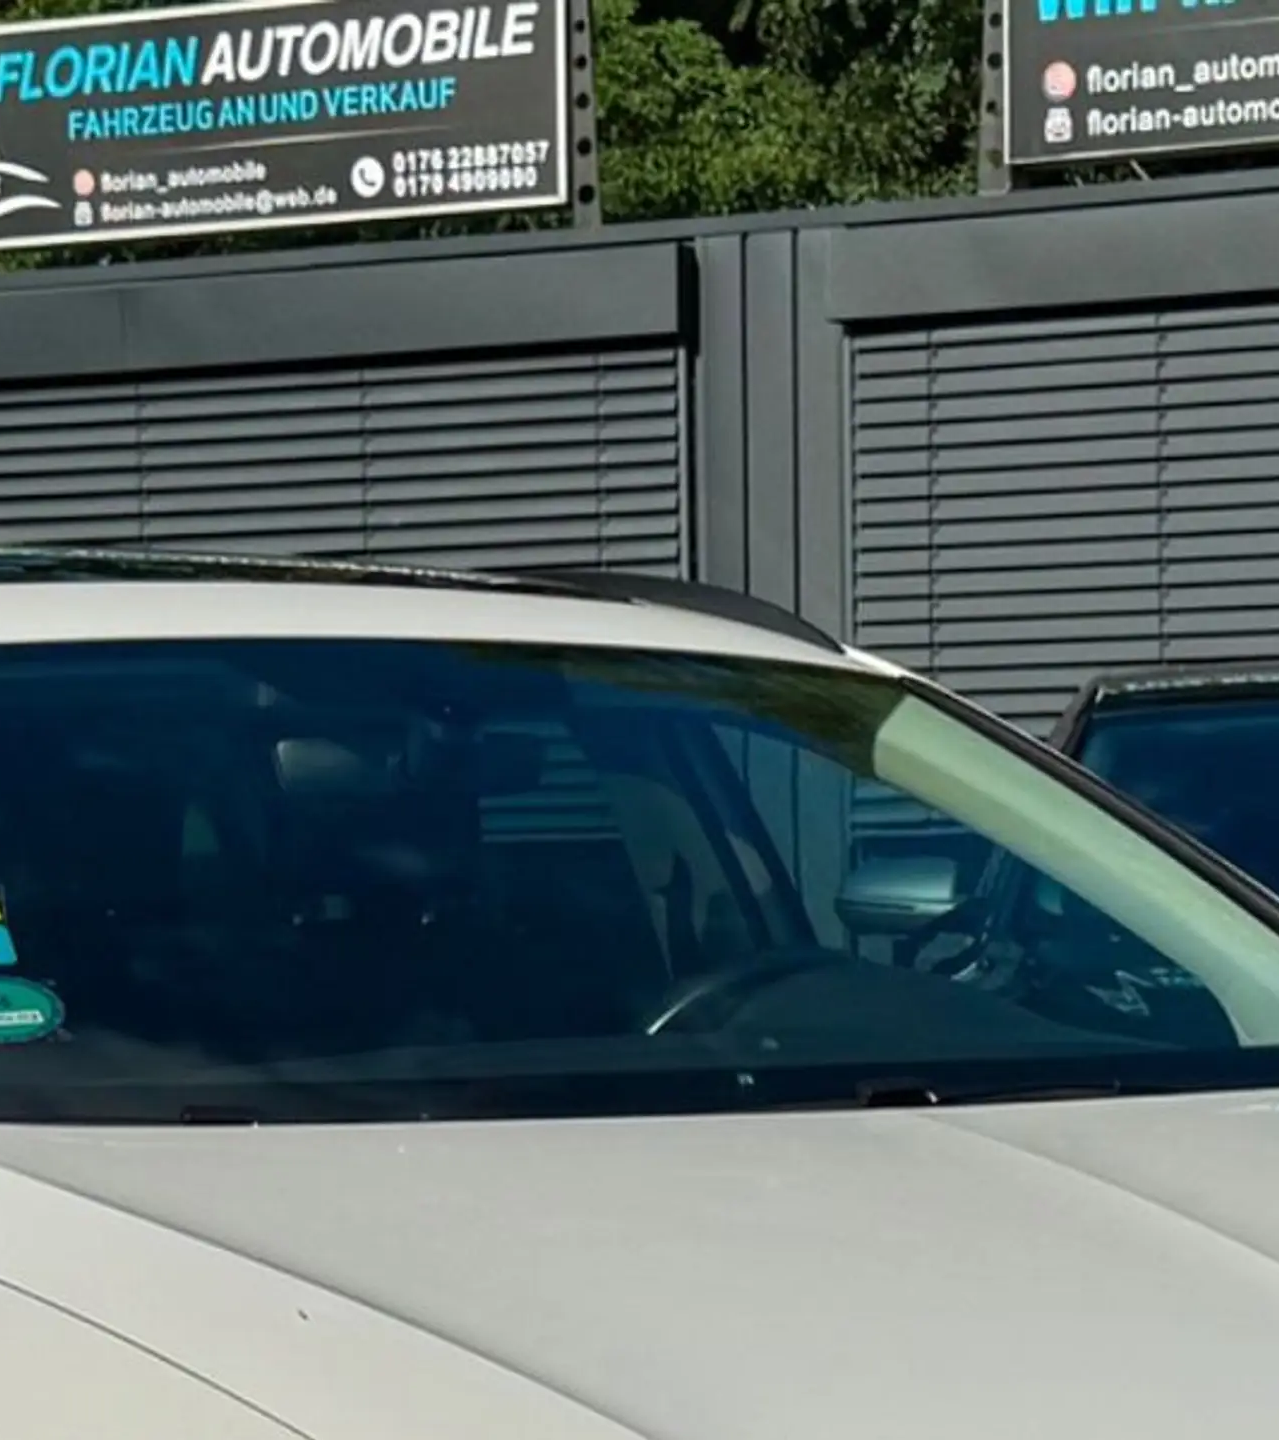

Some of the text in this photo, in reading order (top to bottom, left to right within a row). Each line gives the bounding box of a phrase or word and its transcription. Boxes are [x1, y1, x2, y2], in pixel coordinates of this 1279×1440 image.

[201, 2, 539, 86] AUTOMOBILE
[68, 77, 457, 141] FAHRZEUG AN UND VERKAUF
[392, 147, 445, 173] 0176
